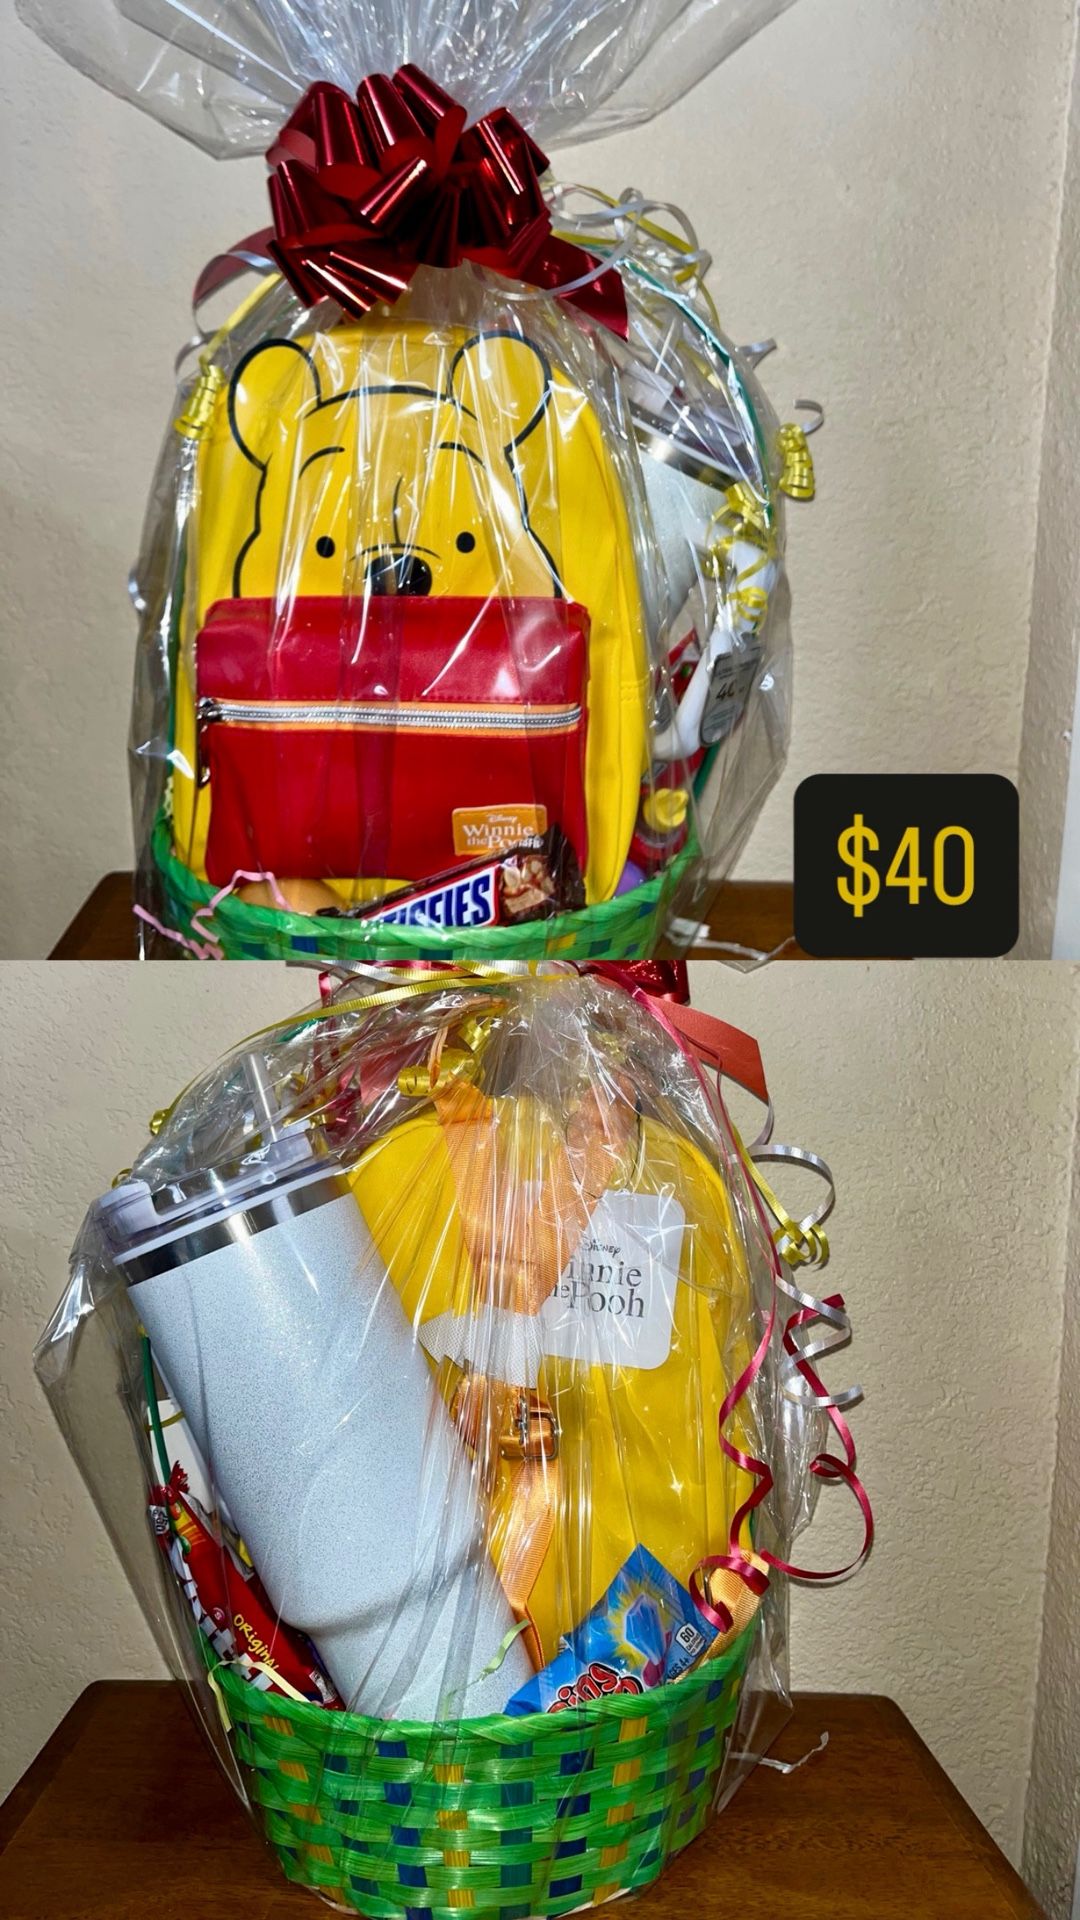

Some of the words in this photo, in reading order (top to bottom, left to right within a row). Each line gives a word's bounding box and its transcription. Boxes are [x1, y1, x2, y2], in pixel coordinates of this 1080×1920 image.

[462, 822, 534, 837] Winnie
[467, 836, 488, 846] the
[566, 1255, 642, 1287] innie
[567, 1280, 645, 1318] Pooh
[680, 1626, 695, 1643] 60
[547, 1662, 619, 1713] ing
